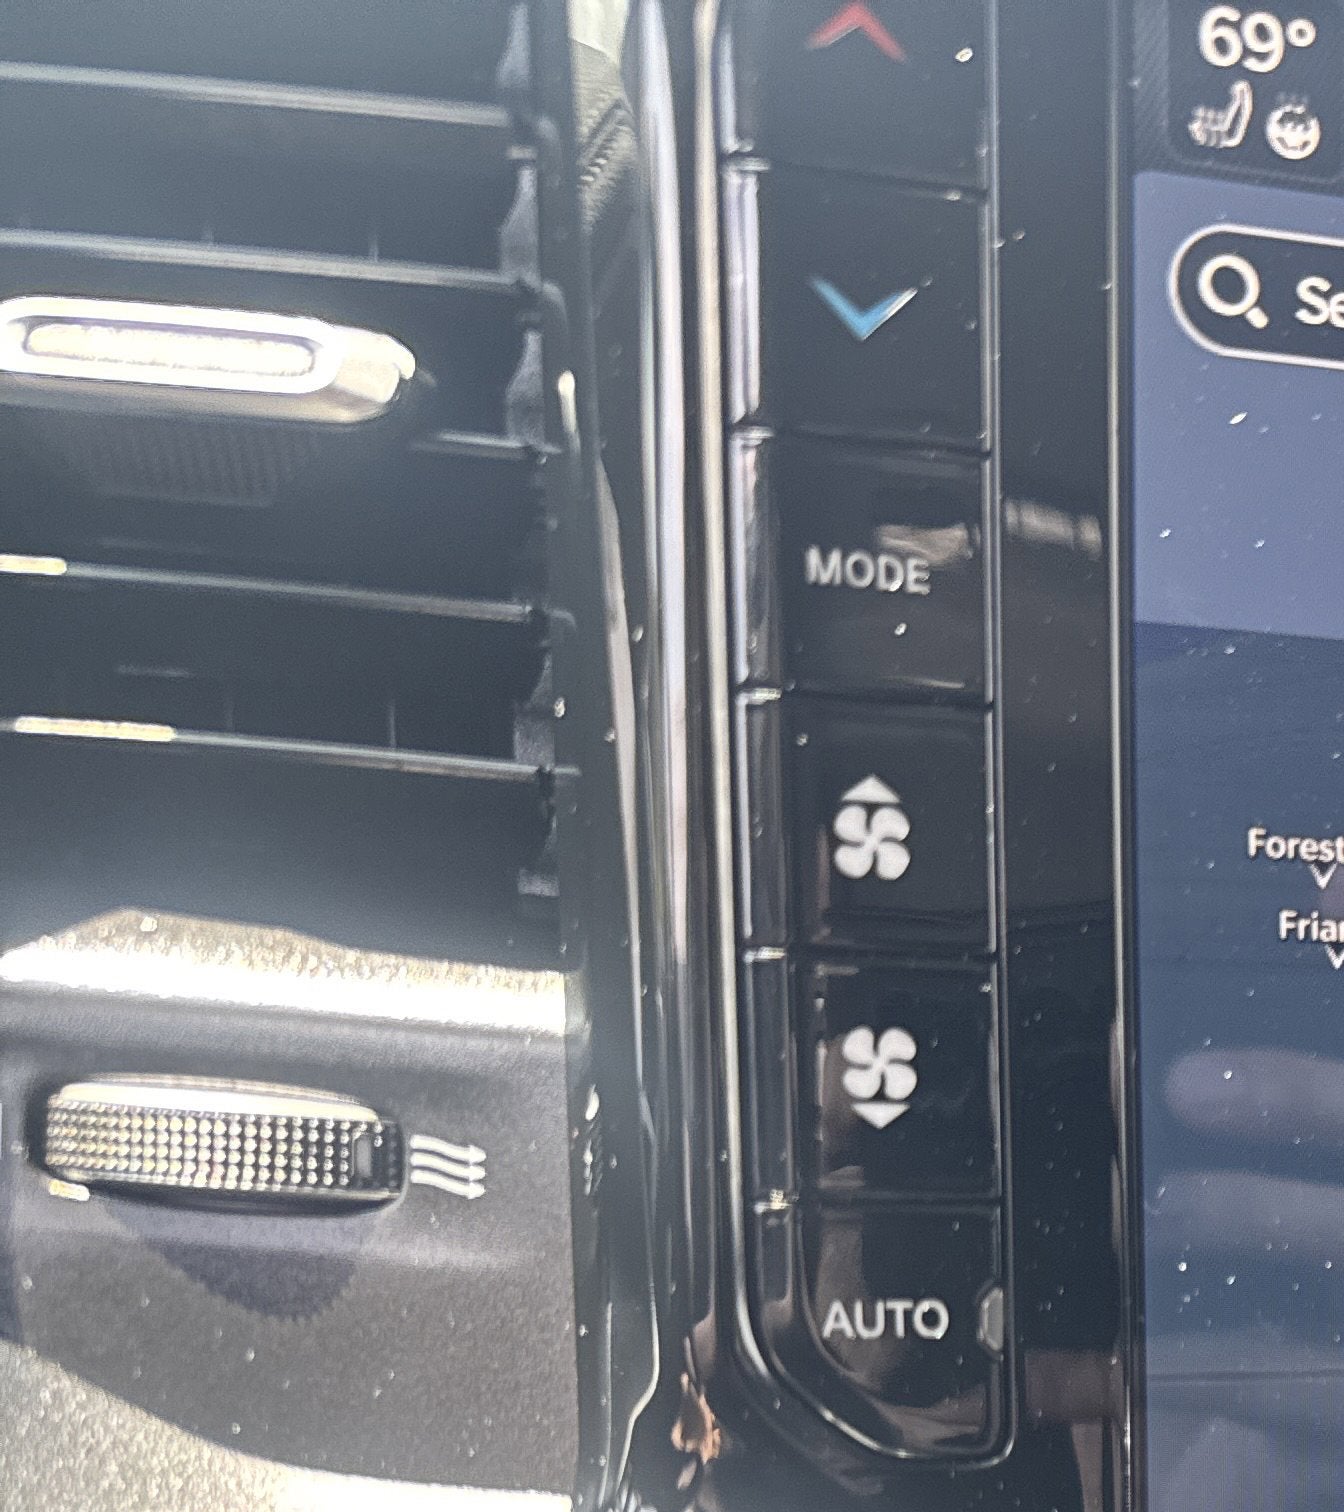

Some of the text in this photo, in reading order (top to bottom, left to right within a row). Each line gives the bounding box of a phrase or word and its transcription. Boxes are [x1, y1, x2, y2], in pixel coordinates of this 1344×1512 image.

[1199, 5, 1317, 72] 69°
[805, 544, 932, 595] MODE
[822, 1299, 949, 1340] AUTO
